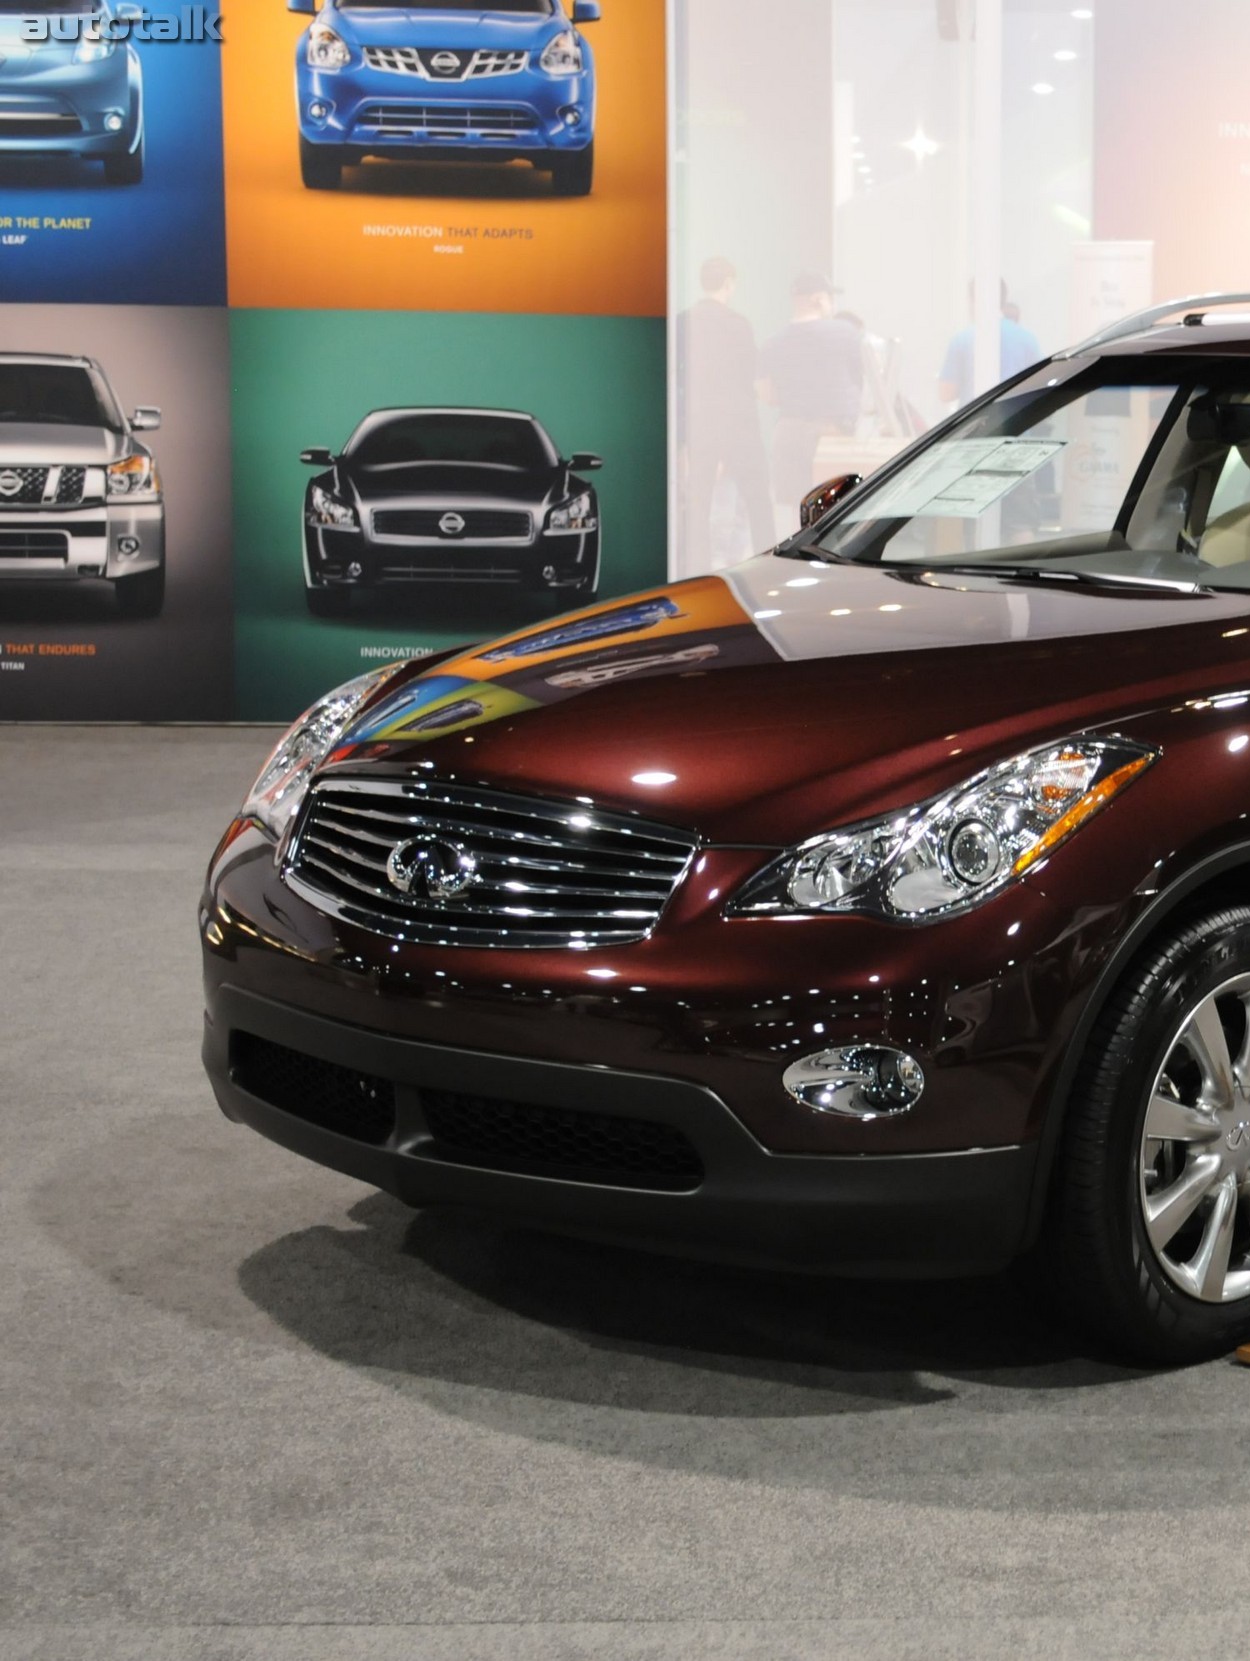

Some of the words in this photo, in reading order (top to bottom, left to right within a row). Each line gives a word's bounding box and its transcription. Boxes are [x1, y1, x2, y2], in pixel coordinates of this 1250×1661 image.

[16, 217, 40, 229] THE
[43, 217, 92, 230] PLANET
[362, 224, 444, 238] INNOVATION
[448, 226, 480, 239] THAT
[483, 227, 534, 240] ADAPTS
[2, 234, 27, 245] LEAF
[6, 643, 35, 655] THAT
[39, 643, 96, 656] ENDURES
[1, 661, 25, 671] TITAN
